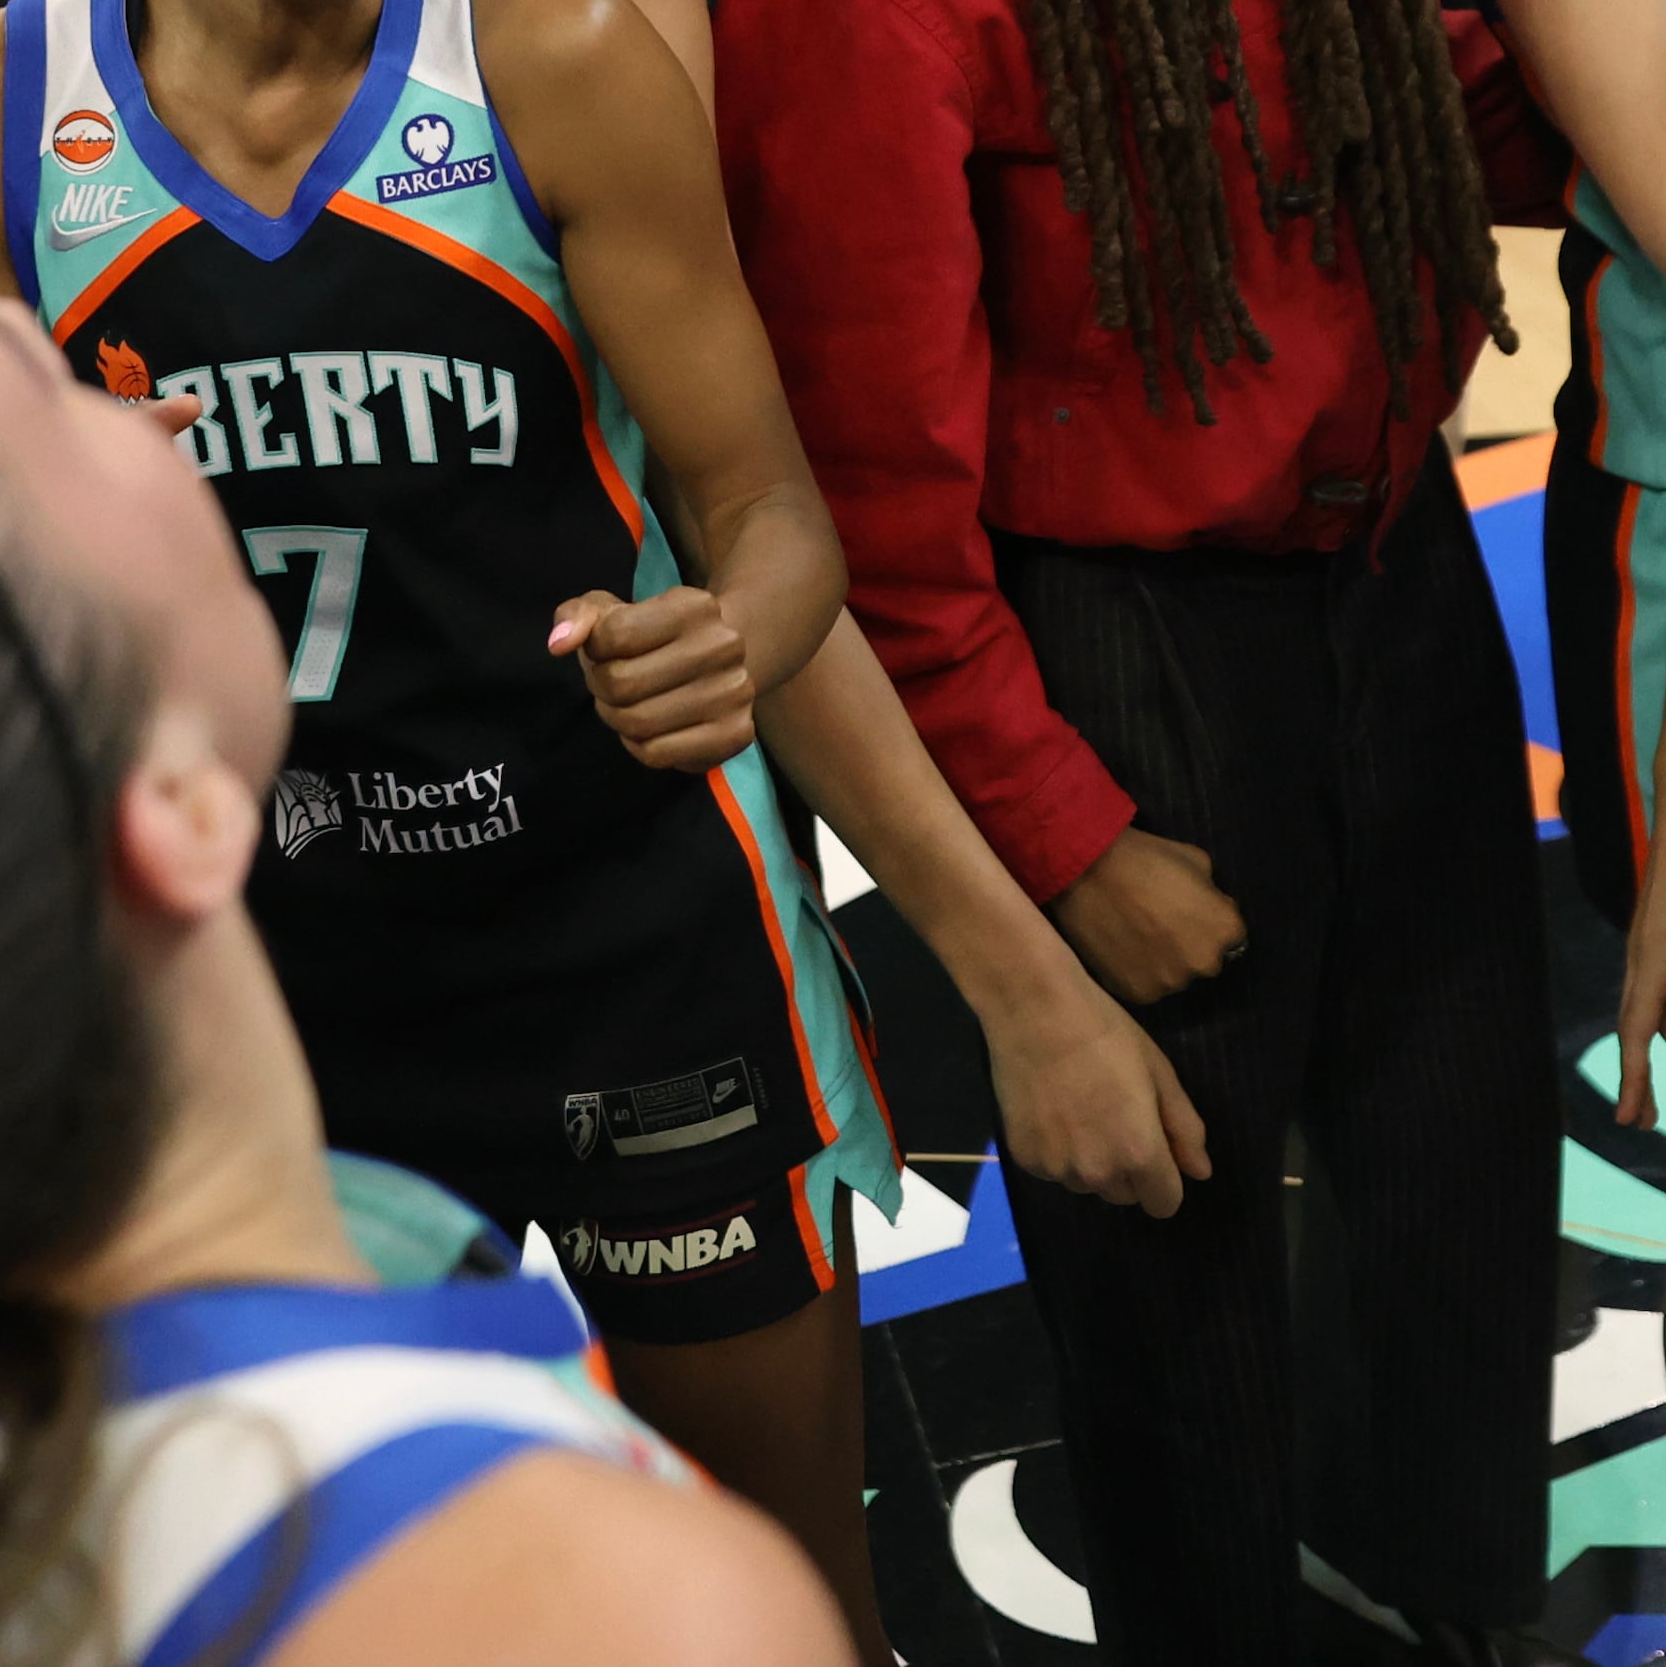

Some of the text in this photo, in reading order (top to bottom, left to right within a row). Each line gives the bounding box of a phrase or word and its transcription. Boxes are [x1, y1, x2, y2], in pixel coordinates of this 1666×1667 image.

[57, 182, 135, 223] NIKE
[381, 157, 493, 199] BARCLAYS
[156, 349, 519, 478] BERTY
[241, 524, 369, 704] 7
[347, 763, 506, 814] Liberty
[358, 795, 525, 854] Mutual
[599, 1215, 757, 1276] WNBA
